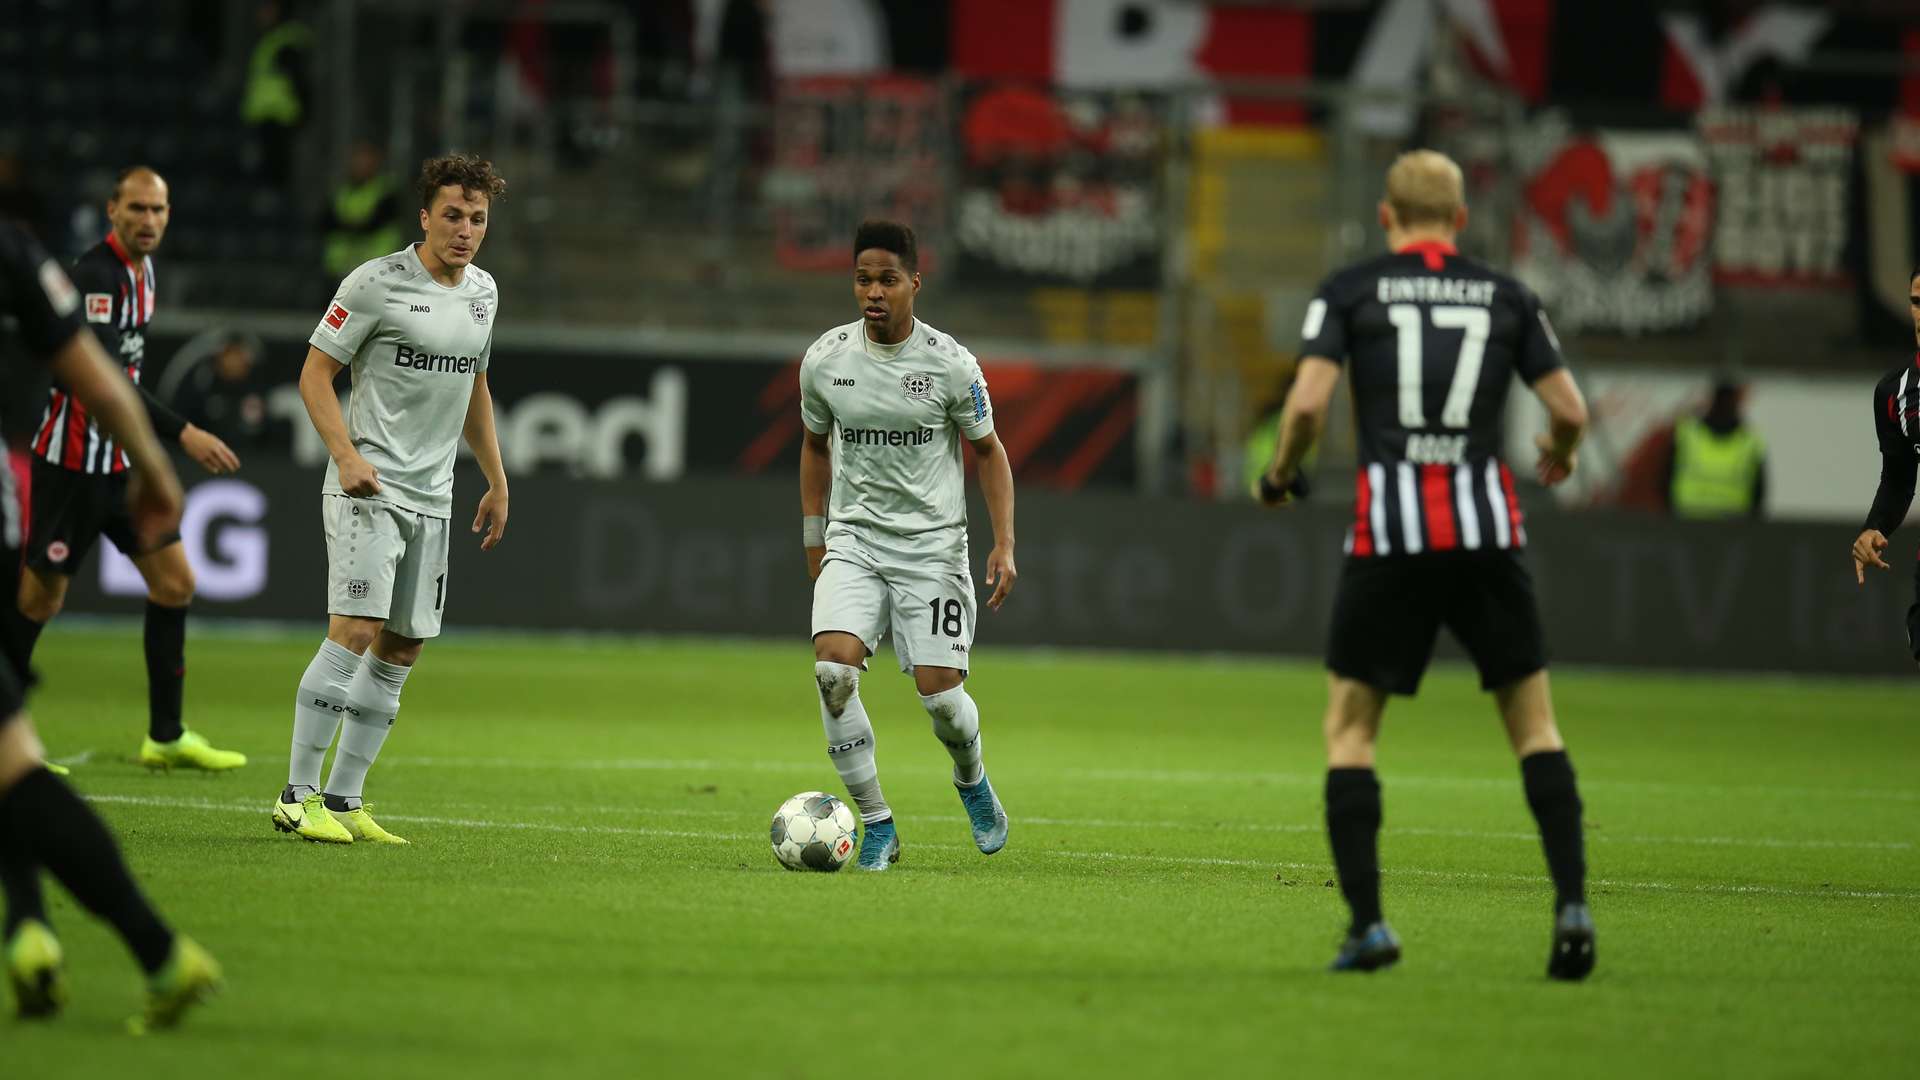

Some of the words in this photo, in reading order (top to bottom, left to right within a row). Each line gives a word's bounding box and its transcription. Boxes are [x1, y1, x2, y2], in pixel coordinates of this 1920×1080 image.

[1377, 276, 1495, 306] EINTRACHT
[409, 304, 430, 313] JAKO
[394, 344, 479, 374] Barmen
[1388, 303, 1491, 428] 17
[832, 378, 855, 387] JAKO
[1406, 433, 1469, 465] RODE
[1793, 538, 1892, 654] la
[929, 597, 962, 637] 18
[951, 643, 967, 653] JAK
